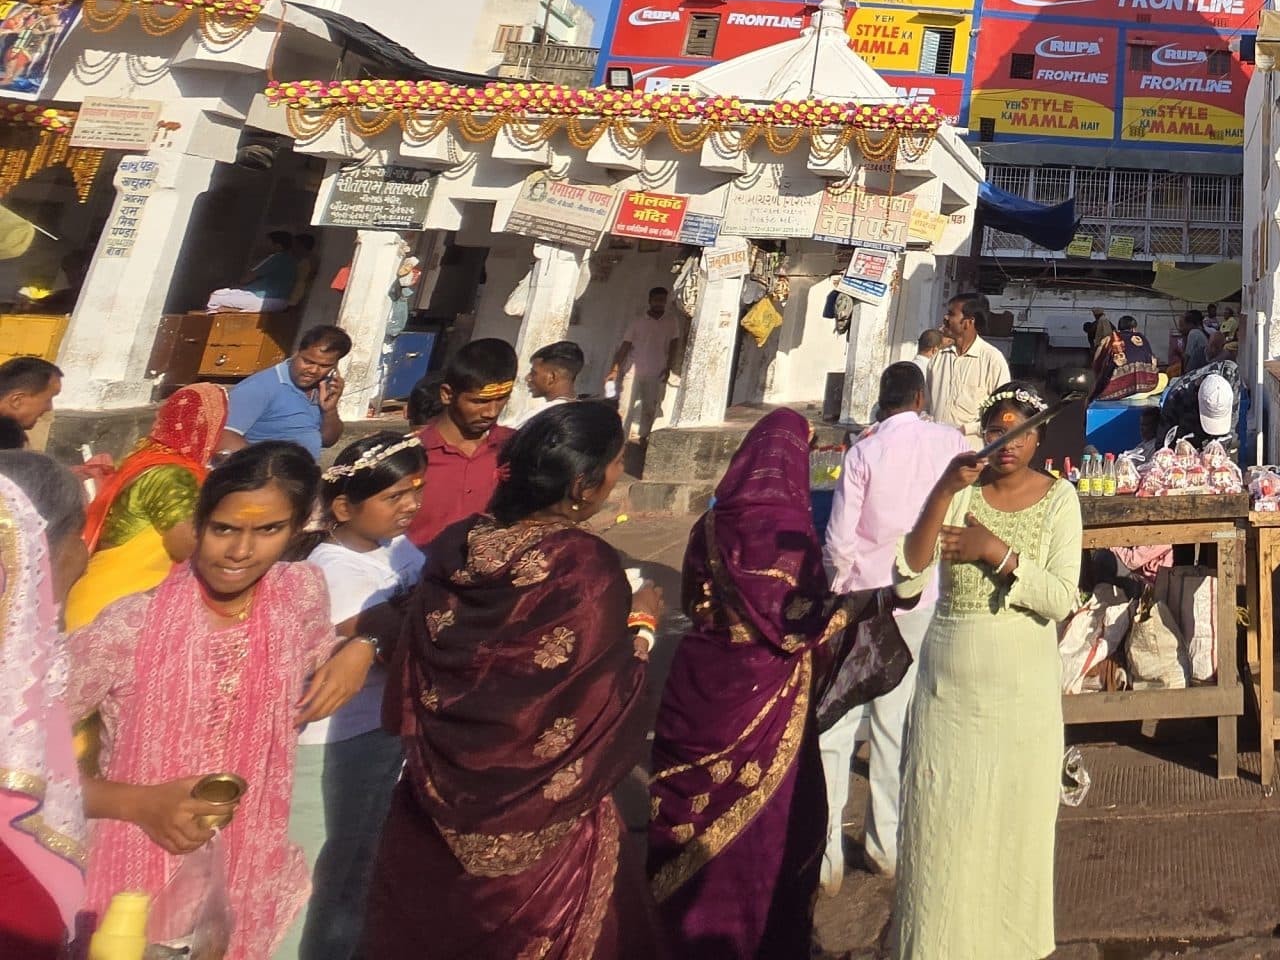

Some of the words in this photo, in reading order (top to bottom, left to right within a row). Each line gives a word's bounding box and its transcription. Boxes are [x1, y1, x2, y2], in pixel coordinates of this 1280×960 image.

[642, 9, 681, 21] RUPA
[727, 13, 804, 28] FRONTLINE
[875, 15, 895, 23] YEH
[856, 24, 900, 39] STYLE
[902, 31, 913, 40] KA
[847, 38, 909, 55] MAMLA
[1050, 40, 1101, 55] RUPA
[1164, 49, 1208, 62] RUPA
[1036, 69, 1109, 84] FRONTLINE
[1140, 75, 1233, 93] FRONTLINE
[1005, 100, 1021, 109] YEH
[1021, 97, 1074, 113] STYLE
[1141, 108, 1157, 118] YEH
[1157, 104, 1208, 120] STYLE
[1001, 111, 1012, 120] KA
[1010, 112, 1079, 130] MAMLA
[1149, 119, 1214, 137] MAMLA
[628, 191, 684, 210] नीलकंठ
[633, 208, 670, 223] मंदिर
